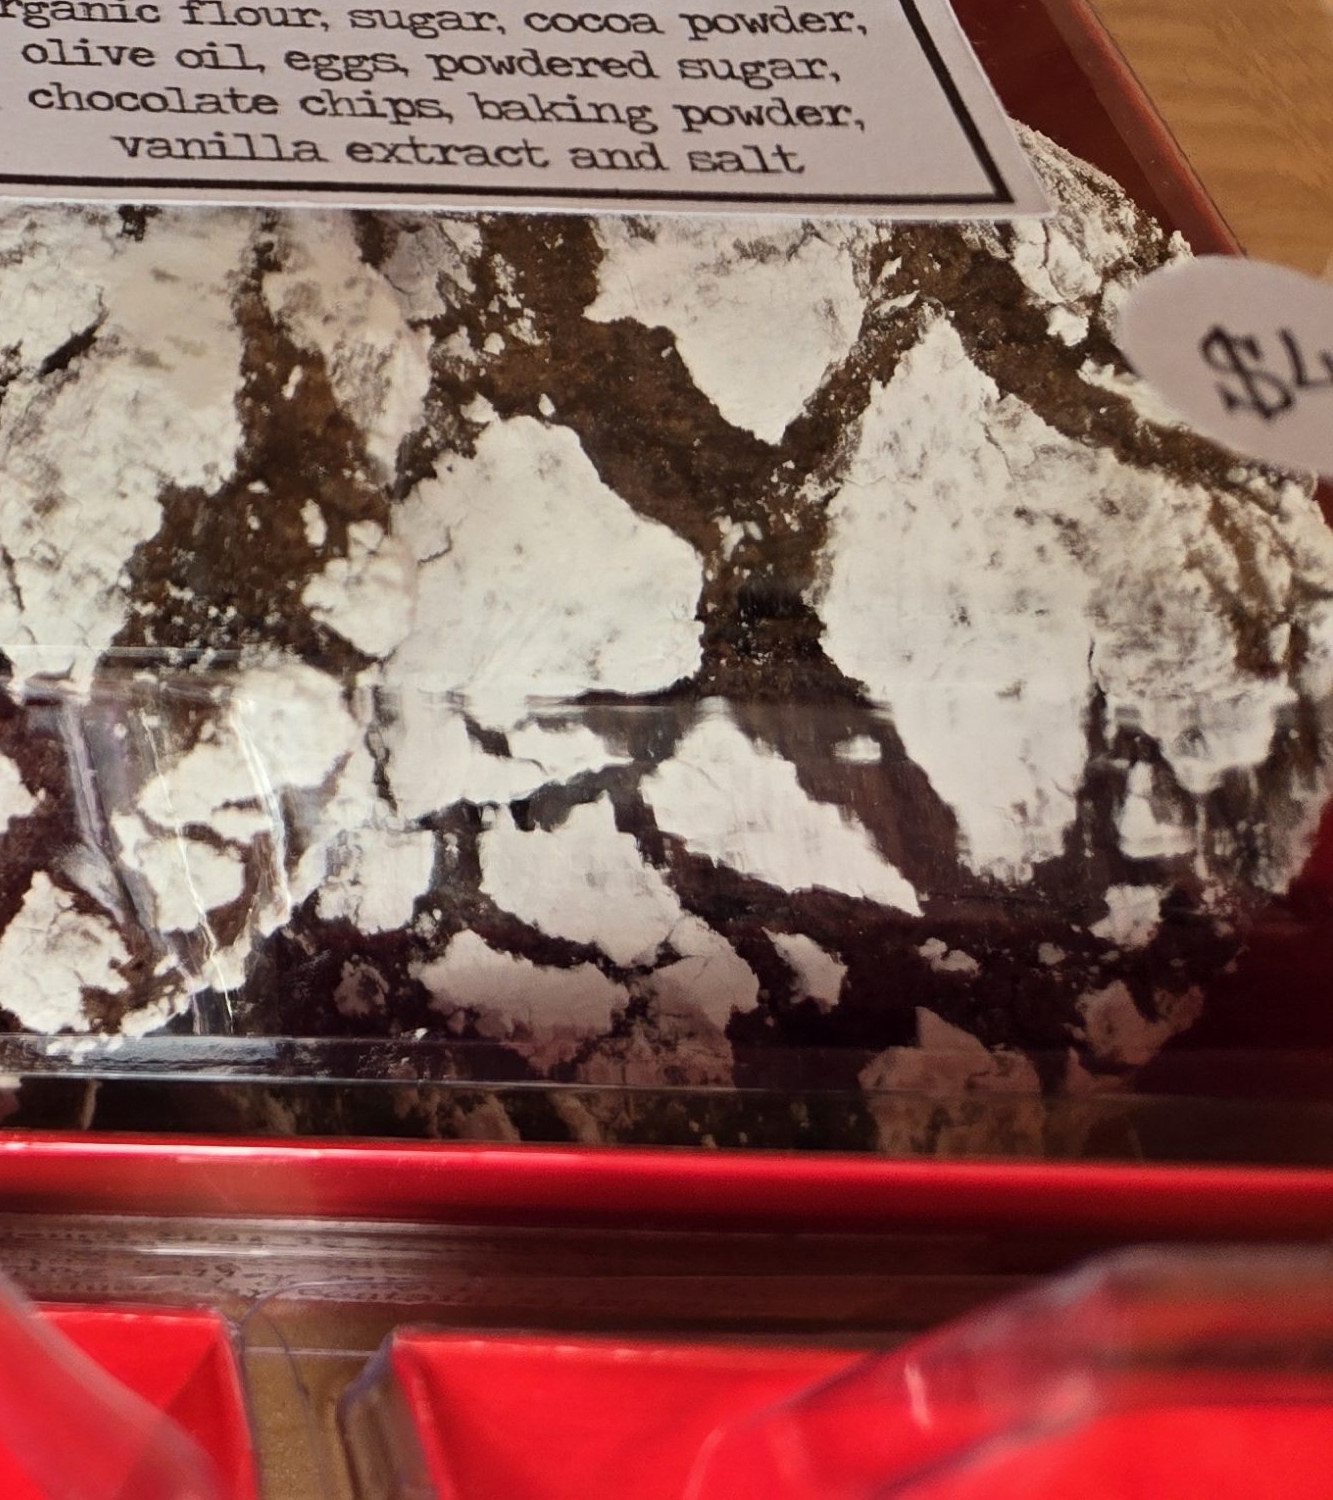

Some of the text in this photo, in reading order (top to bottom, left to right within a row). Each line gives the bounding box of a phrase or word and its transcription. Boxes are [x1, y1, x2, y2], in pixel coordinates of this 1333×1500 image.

[347, 4, 507, 39] sugar,
[523, 9, 665, 36] cocoa
[677, 4, 869, 42] powder,
[21, 37, 841, 90] olive oil, eggs, powdered sugar,
[27, 81, 866, 136] chocolate chips, baking powder,
[111, 131, 806, 176] vanilla extract and salt
